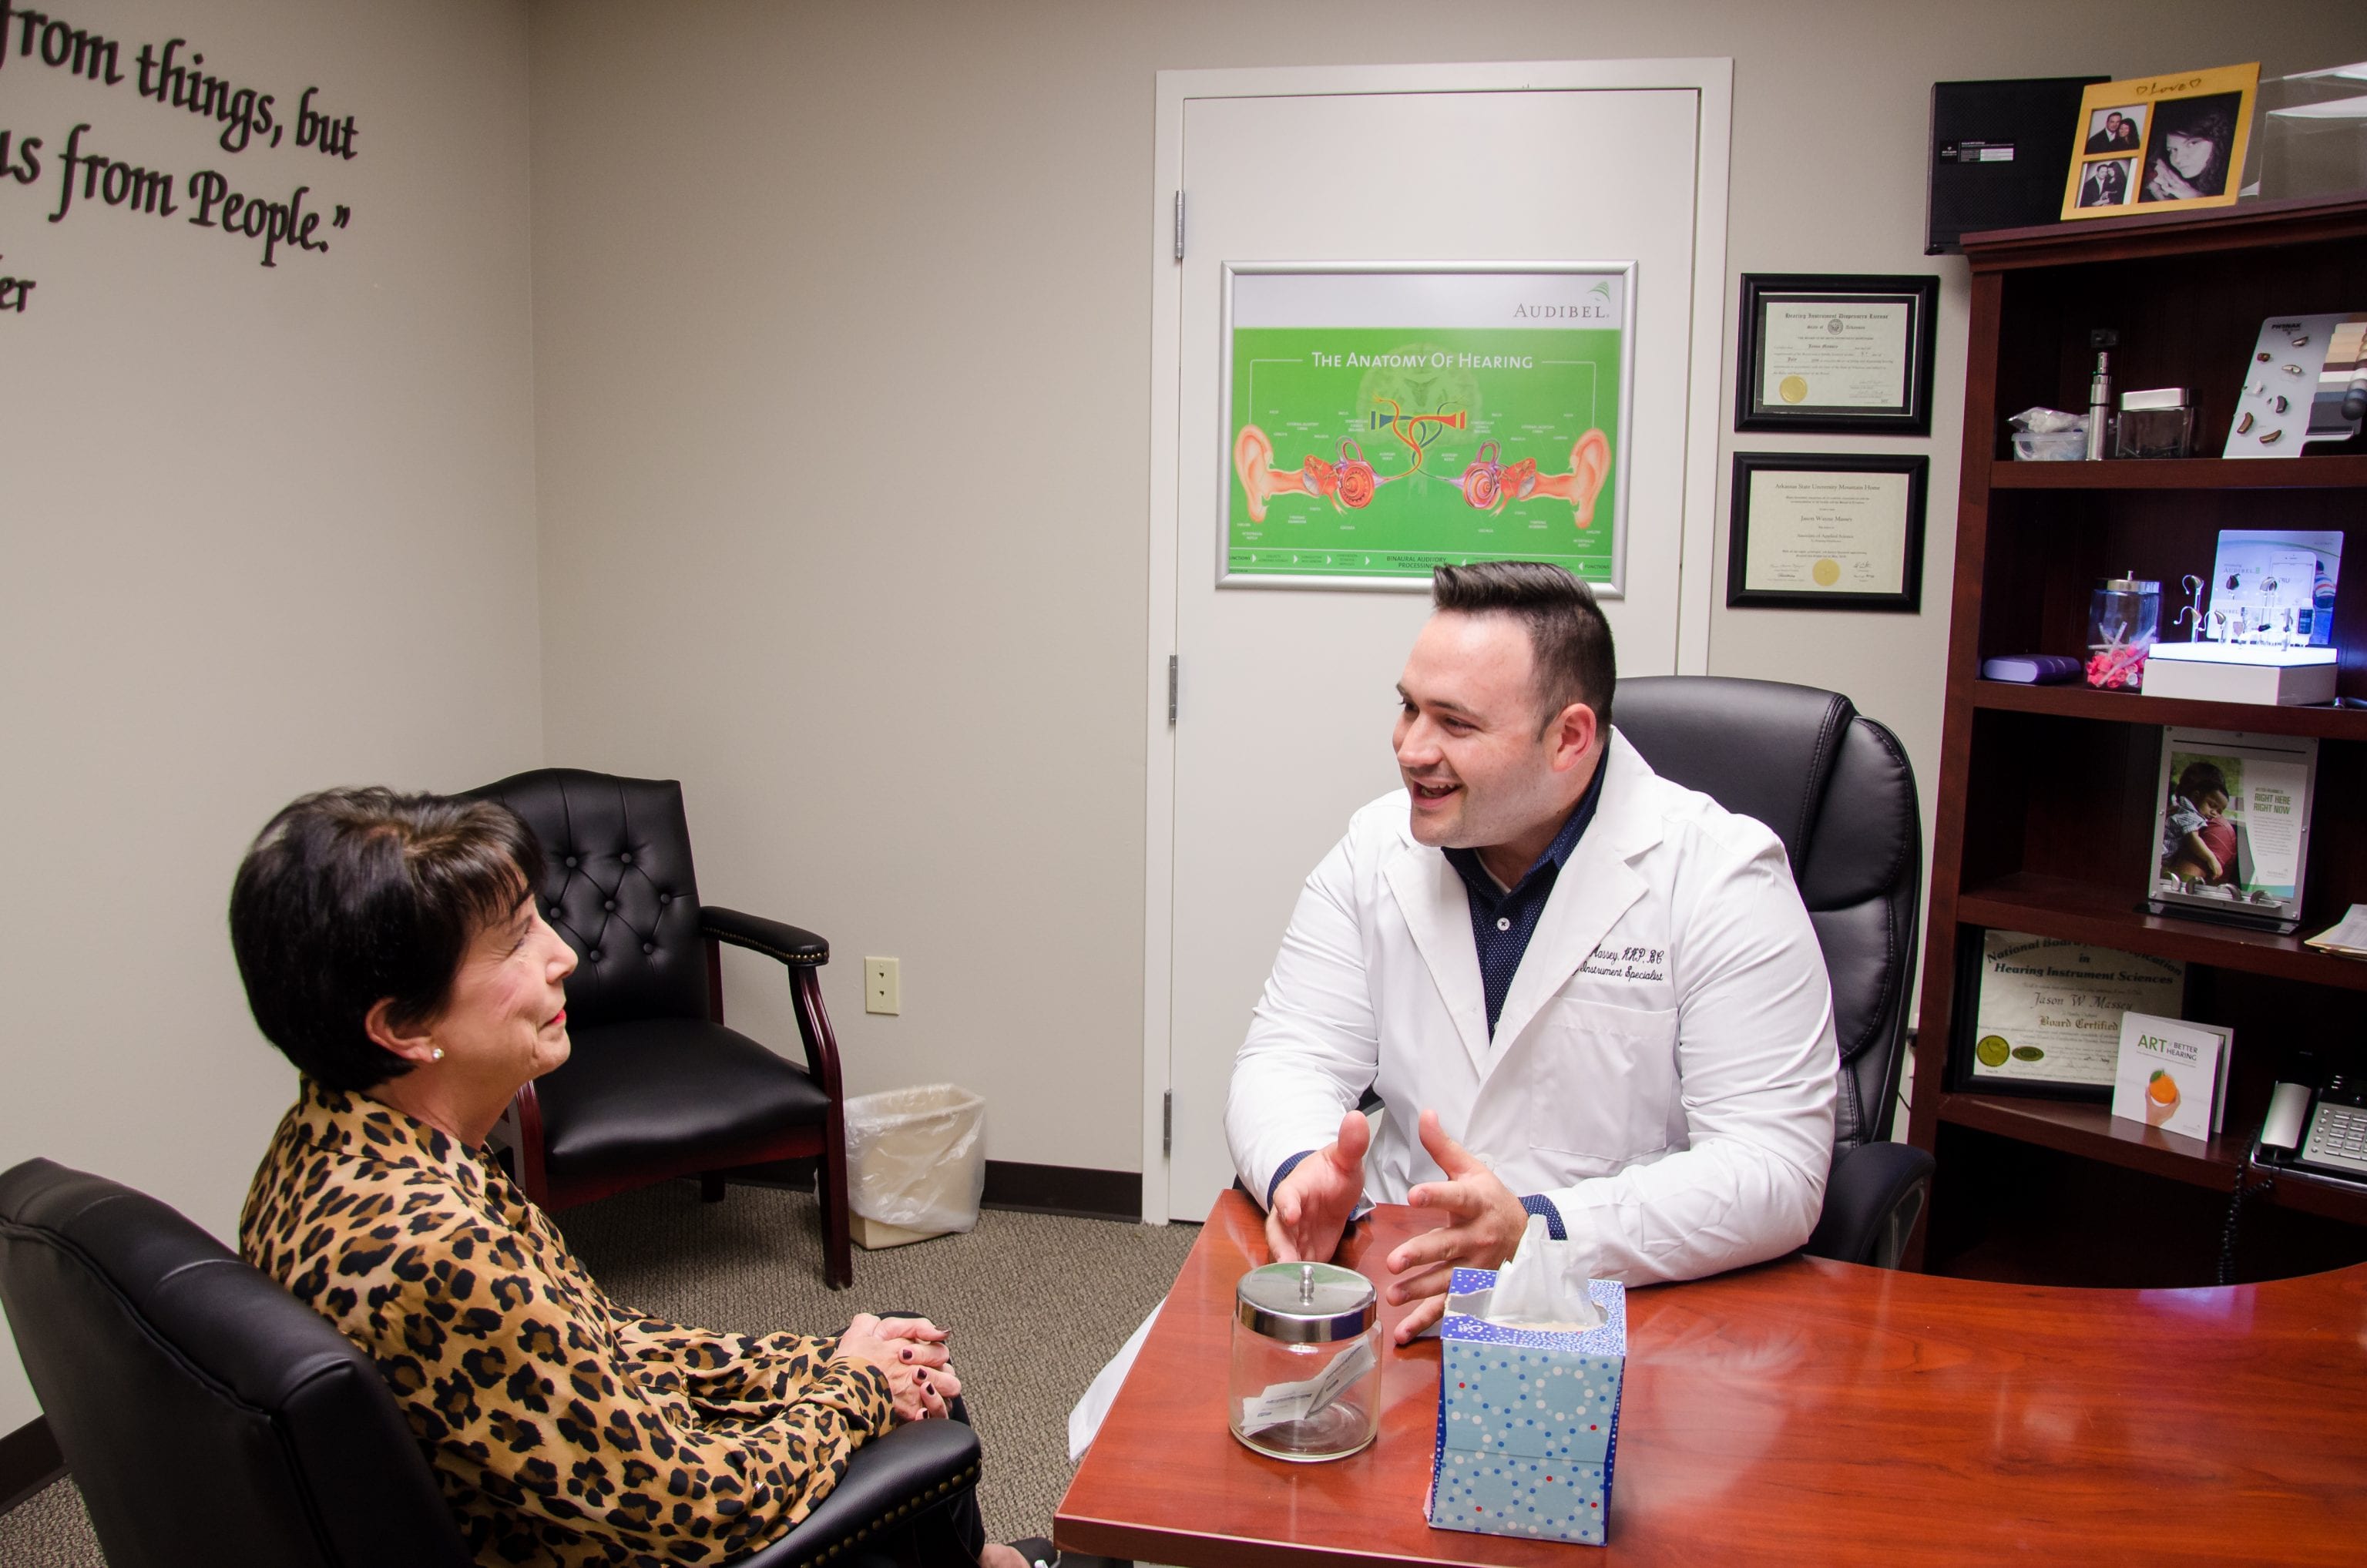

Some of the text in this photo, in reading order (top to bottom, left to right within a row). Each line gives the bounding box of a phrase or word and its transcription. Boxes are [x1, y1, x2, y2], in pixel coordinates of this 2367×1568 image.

[2149, 82, 2187, 96] Love
[135, 39, 283, 153] things,
[296, 86, 359, 160] but
[48, 123, 178, 223] from
[2255, 793, 2291, 805] RIGHT HERE
[2254, 803, 2291, 814] RIGHT NOW
[1986, 938, 2040, 963] National
[2079, 952, 2090, 963] in
[1580, 960, 1664, 982] Instrument Specialist
[1994, 962, 2174, 984] Hearing Instrument Sciences
[2030, 992, 2064, 1009] Jason
[2070, 993, 2086, 1007] W
[2040, 1016, 2119, 1031] Board Certified
[2137, 1034, 2198, 1053] ART BETTER
[2166, 1048, 2197, 1061] HEARING
